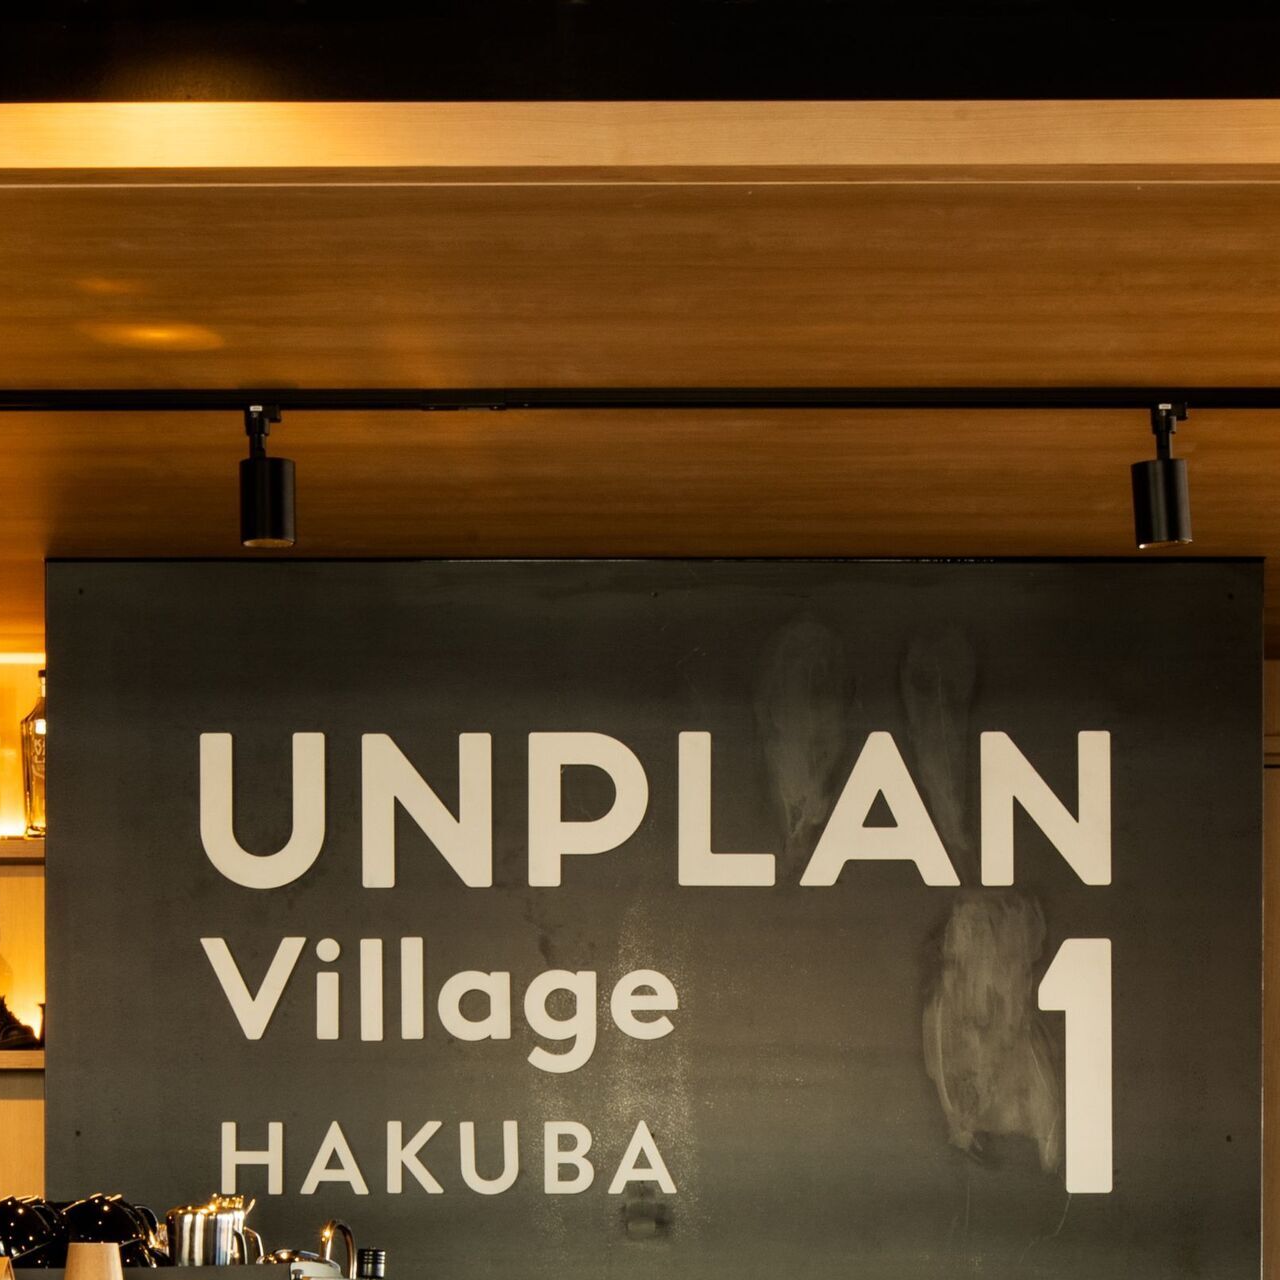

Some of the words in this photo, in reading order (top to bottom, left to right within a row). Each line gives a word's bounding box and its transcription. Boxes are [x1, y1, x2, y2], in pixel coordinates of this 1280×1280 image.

[199, 730, 1112, 889] UNPLAN
[200, 936, 679, 1073] Village
[1038, 938, 1112, 1193] 1
[220, 1120, 678, 1195] HAKUBA
